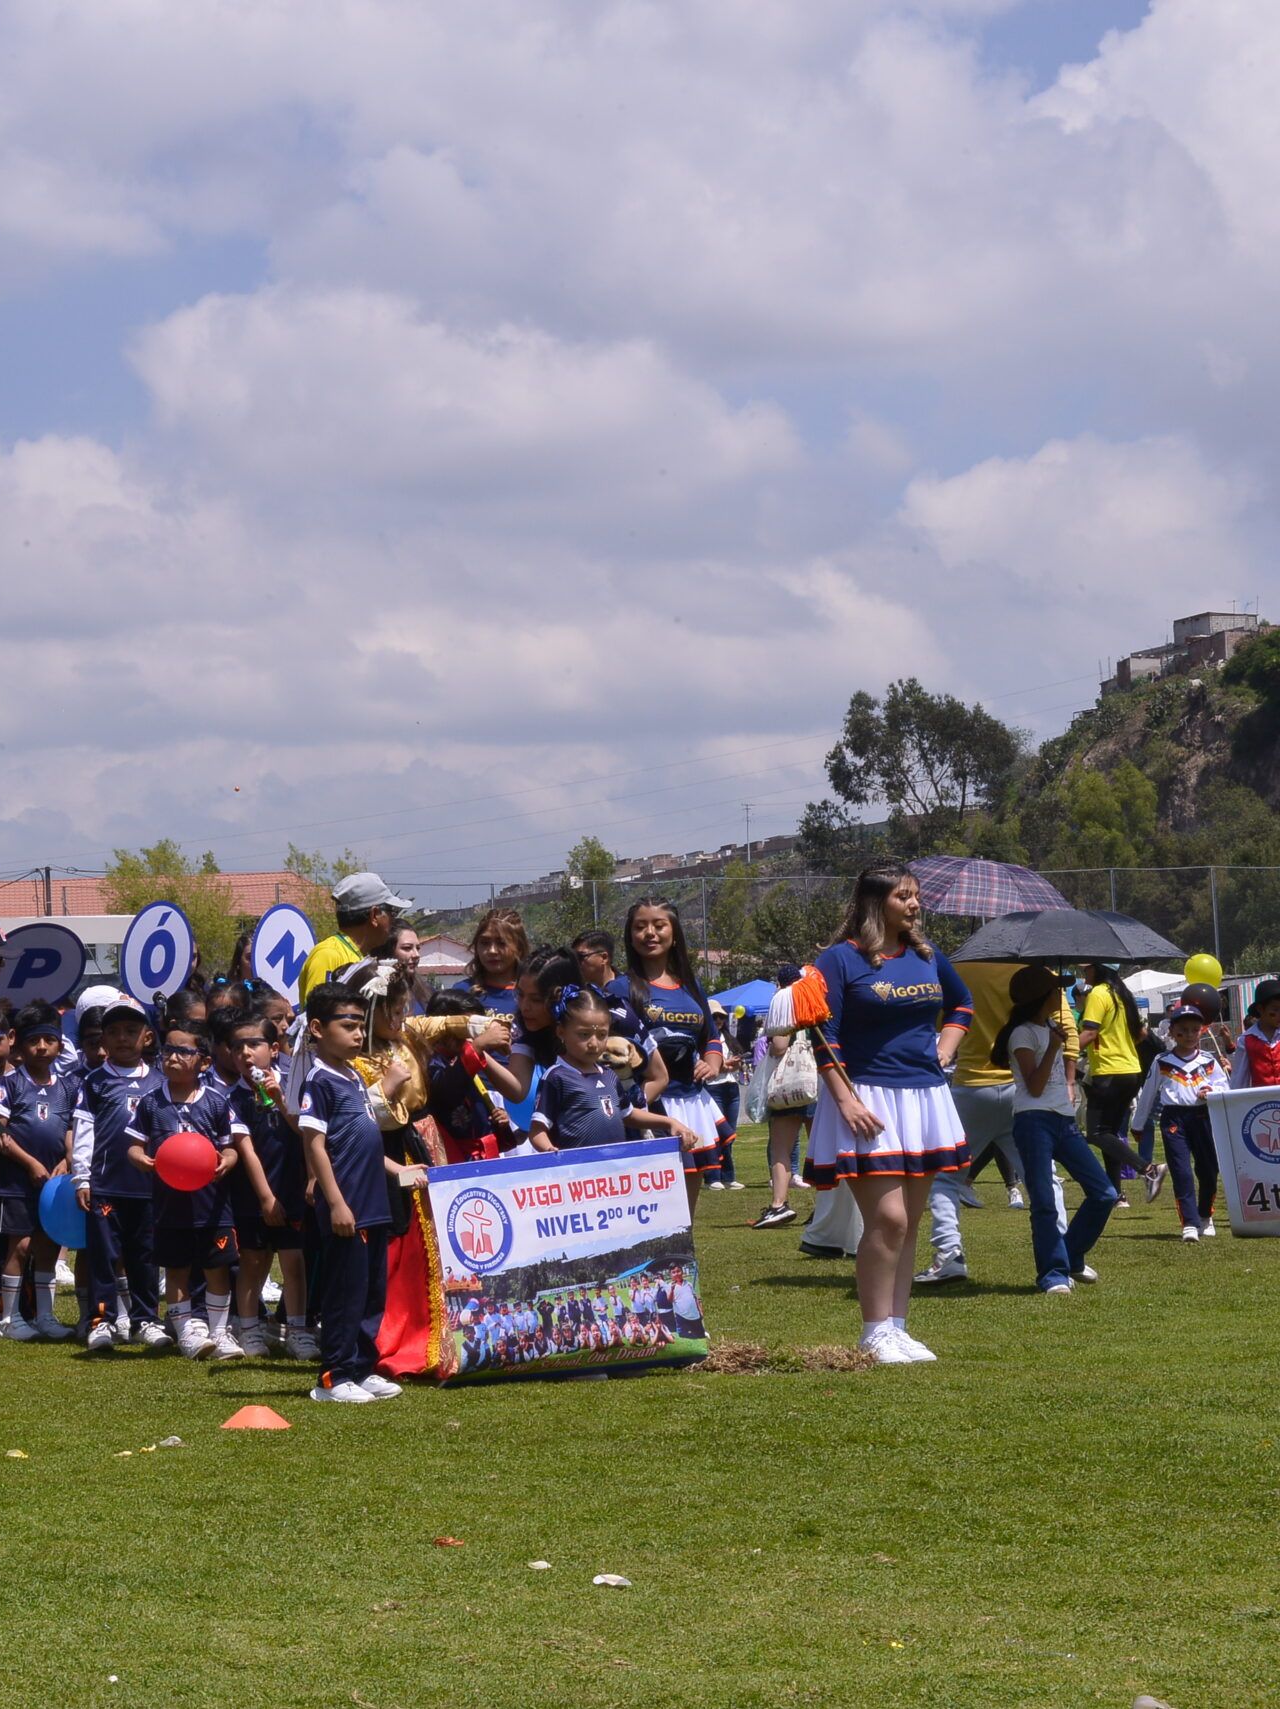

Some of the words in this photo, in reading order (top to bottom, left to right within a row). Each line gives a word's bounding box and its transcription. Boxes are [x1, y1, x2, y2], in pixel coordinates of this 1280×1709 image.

[512, 1183, 563, 1210] VIGO
[568, 1174, 632, 1202] WORLD
[638, 1169, 675, 1192] CUP
[536, 1213, 593, 1238] NIVEL
